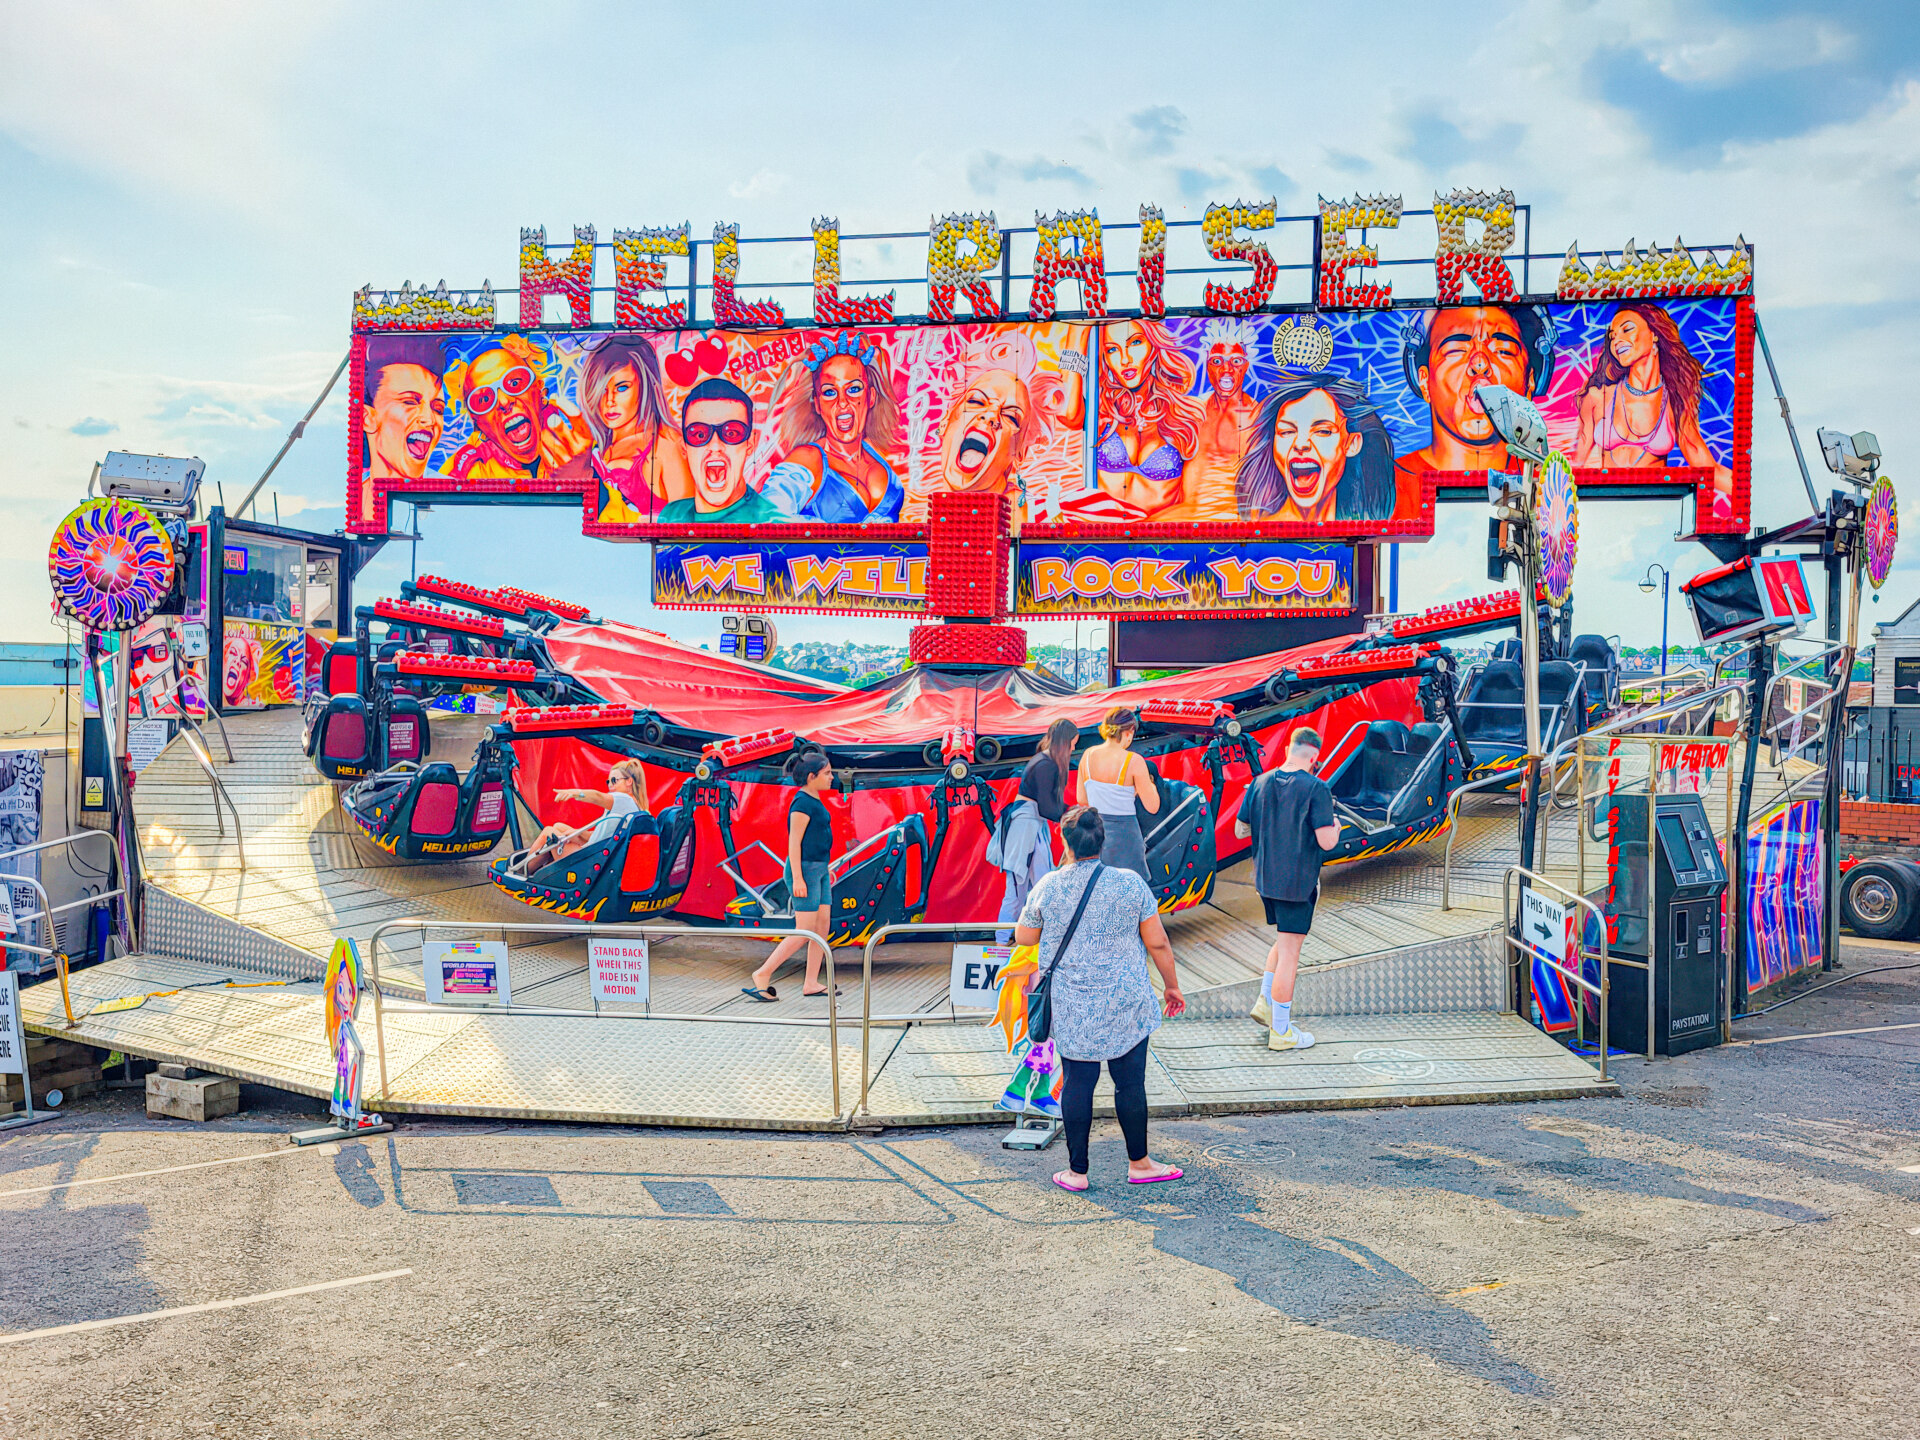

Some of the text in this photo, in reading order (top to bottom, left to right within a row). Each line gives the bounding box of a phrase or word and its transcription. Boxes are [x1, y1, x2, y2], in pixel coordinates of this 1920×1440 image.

[893, 327, 949, 365] THE
[1274, 319, 1292, 367] MINISTRY
[1311, 325, 1332, 373] OF SOUND
[906, 363, 931, 490] POWER
[682, 554, 1336, 602] WE WILL ROCK YOU
[260, 624, 277, 641] THE
[279, 626, 299, 642] CAR
[1660, 743, 1729, 772] PAY STATION
[421, 839, 492, 853] HELLRAISER
[566, 871, 577, 884] 19
[842, 897, 857, 909] 20
[1525, 894, 1562, 925] THIS WAY
[593, 946, 643, 958] STAND BACK
[596, 959, 641, 970] WHEN THIS
[599, 971, 639, 983] RIDE IS IN
[603, 985, 636, 995] MOTION
[1672, 1013, 1710, 1031] PAYSTATION
